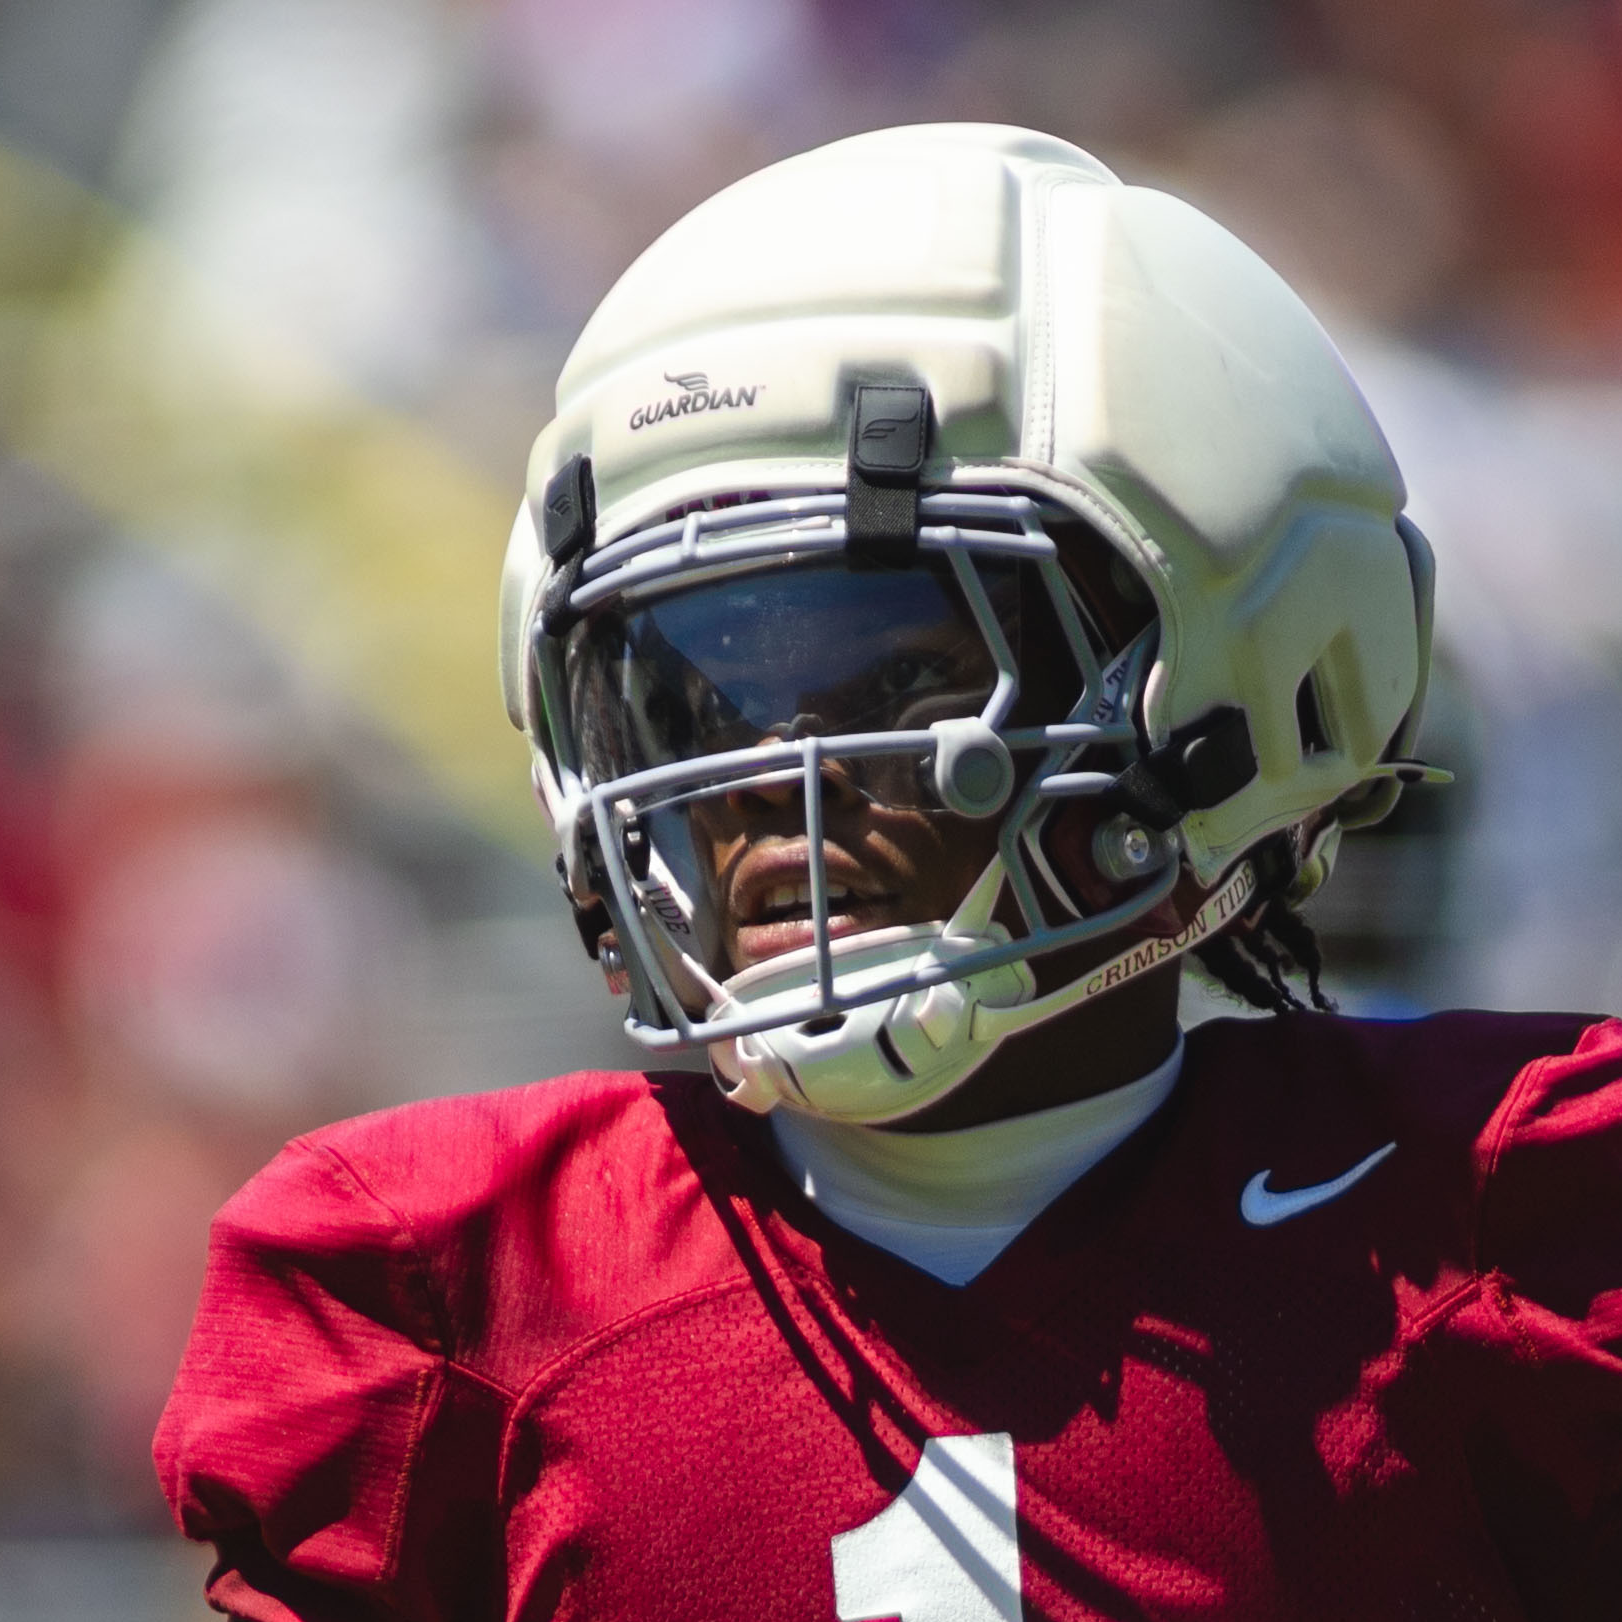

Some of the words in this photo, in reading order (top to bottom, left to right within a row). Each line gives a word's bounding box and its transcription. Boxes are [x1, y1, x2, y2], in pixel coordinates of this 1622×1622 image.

[630, 386, 758, 430] GUARDIAN
[1085, 911, 1207, 996] CRIMSON
[1213, 862, 1256, 919] TIDE
